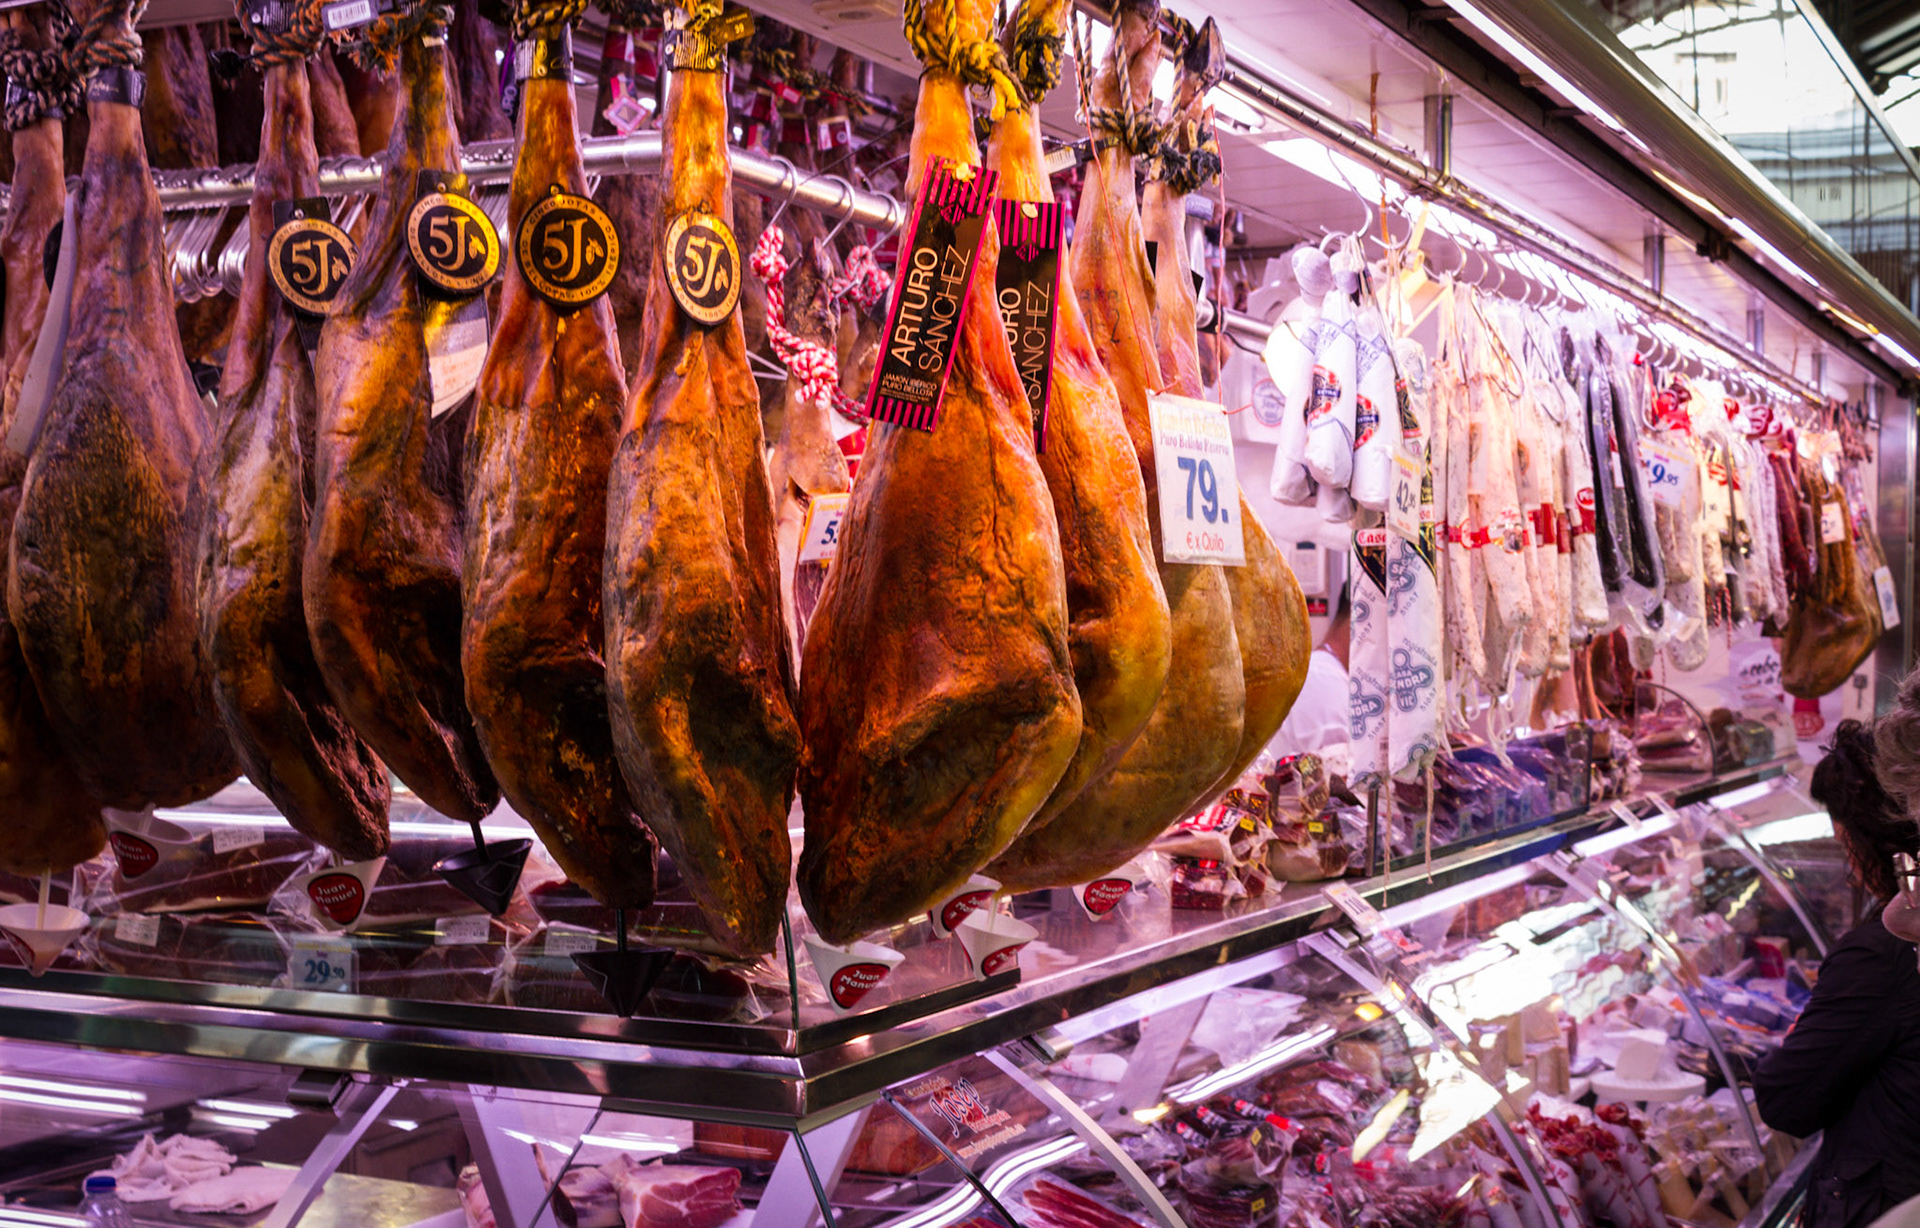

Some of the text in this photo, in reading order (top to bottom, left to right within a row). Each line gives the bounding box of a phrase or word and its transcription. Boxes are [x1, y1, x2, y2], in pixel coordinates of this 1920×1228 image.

[528, 199, 597, 226] CINCO JOTAS
[291, 238, 333, 297] 5J
[429, 214, 471, 272] 5J
[543, 217, 589, 282] 5J
[681, 234, 725, 299] 5J
[524, 259, 566, 299] BELLOTA
[580, 277, 607, 298] 100%
[890, 247, 939, 367] ARTURO
[918, 243, 972, 373] SÁNCHEZ
[998, 287, 1022, 357] URO
[881, 379, 904, 390] PURO
[903, 385, 935, 398] BELLOTA
[1160, 429, 1230, 456] Puro Bellota Reserva
[1186, 531, 1225, 552] € x Quilo
[317, 883, 346, 896] Juan
[1100, 883, 1124, 893] Juan
[852, 969, 881, 981] Juan
[929, 1076, 990, 1139] Josep
